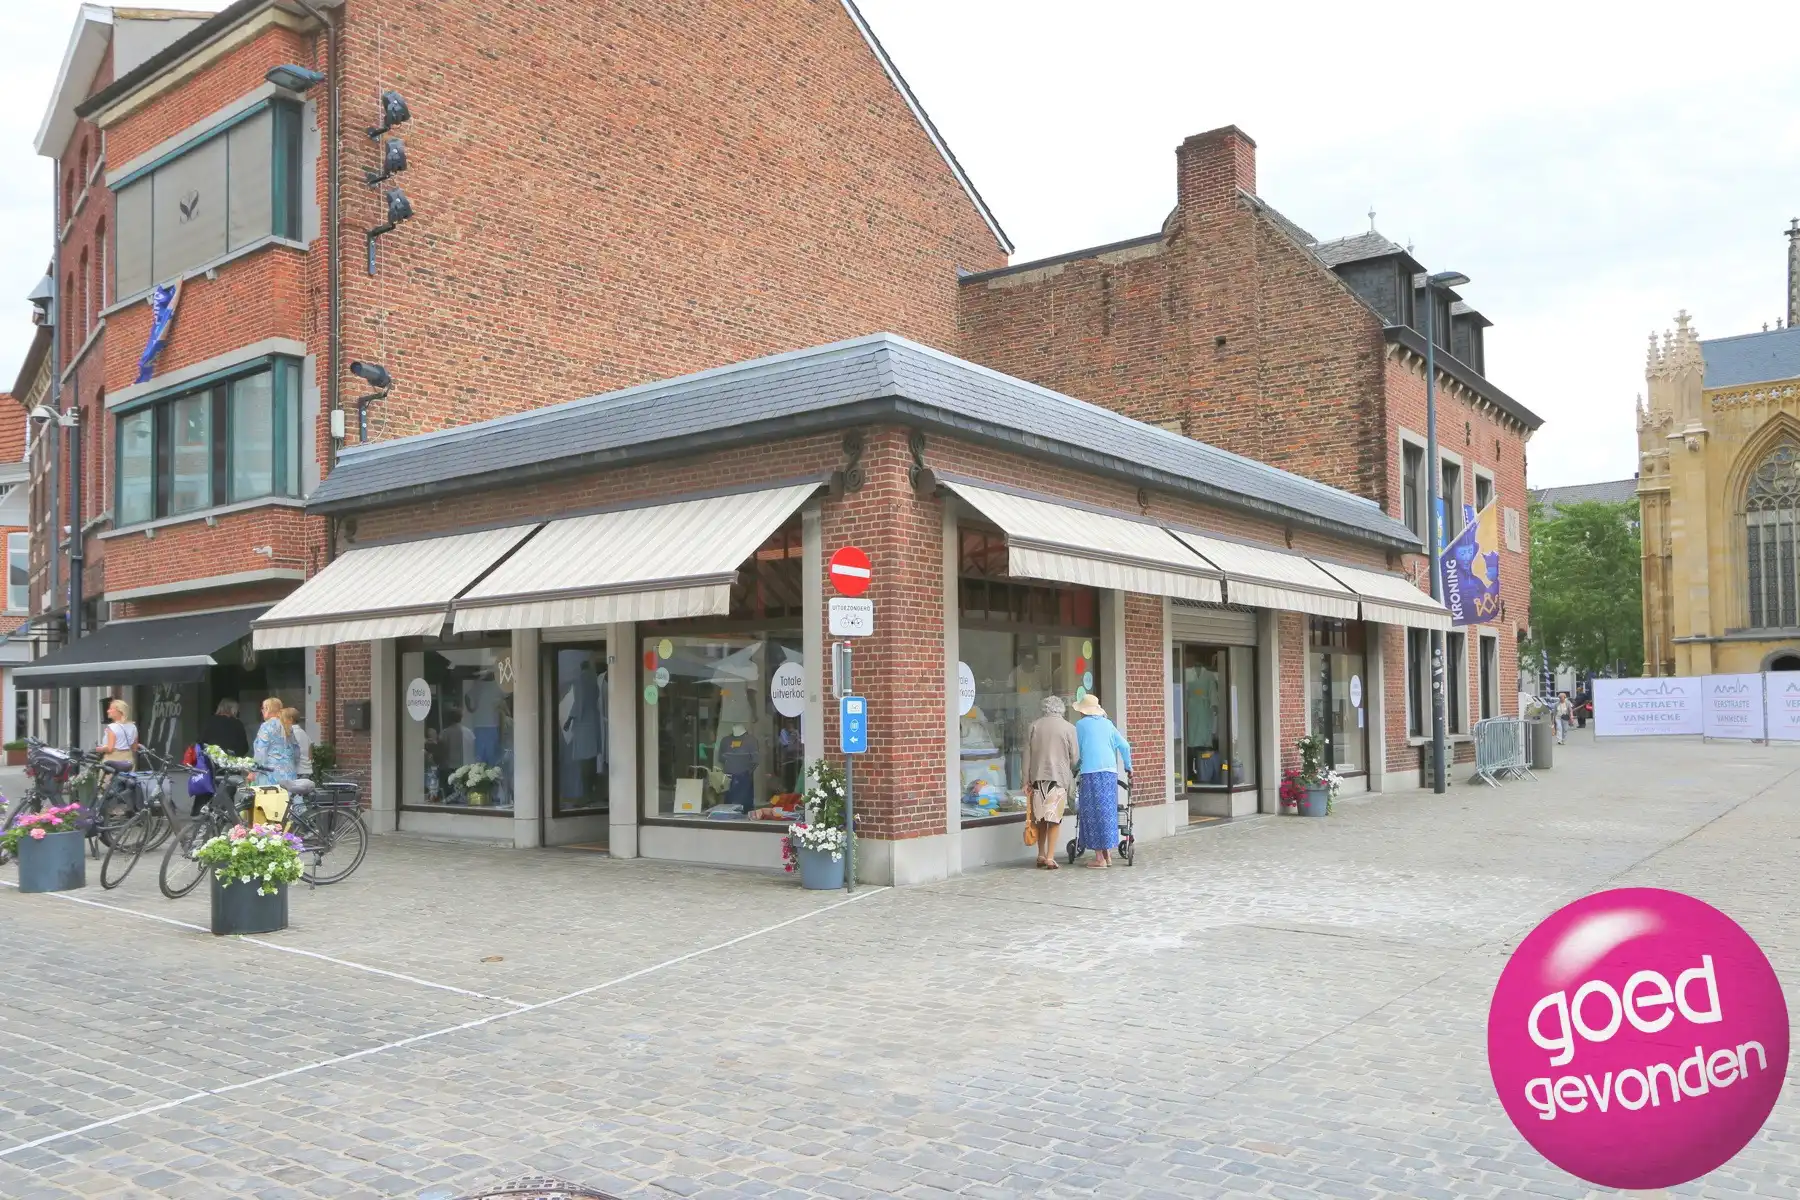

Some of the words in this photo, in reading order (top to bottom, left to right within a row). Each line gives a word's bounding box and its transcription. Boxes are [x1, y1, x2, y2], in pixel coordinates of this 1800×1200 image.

[1445, 559, 1464, 621] KRONING
[831, 604, 871, 612] UITGEZONDERD
[780, 675, 802, 687] Totale
[772, 688, 805, 700] uitverkoo
[1618, 700, 1685, 709] VERSTRAETE
[1713, 700, 1750, 708] VERSTRAETE
[1623, 713, 1681, 722] VANHECKE
[1717, 715, 1748, 723] VANHECKE
